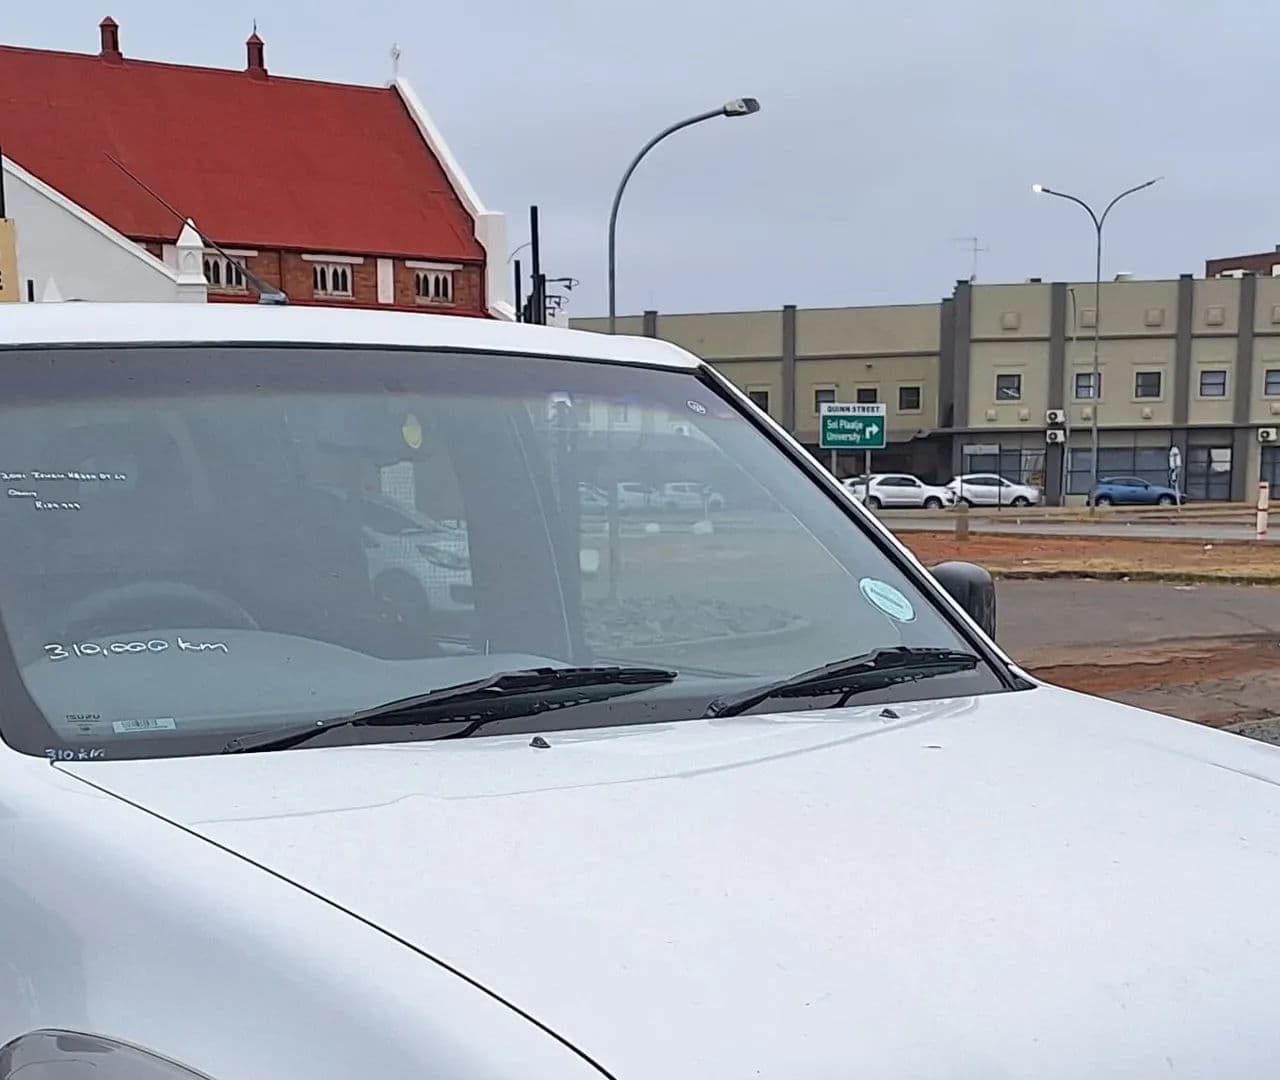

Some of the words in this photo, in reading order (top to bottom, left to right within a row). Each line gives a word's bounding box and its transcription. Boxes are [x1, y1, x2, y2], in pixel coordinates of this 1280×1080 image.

[826, 432, 861, 444] University
[44, 638, 169, 661] 310,000
[177, 637, 229, 653] km
